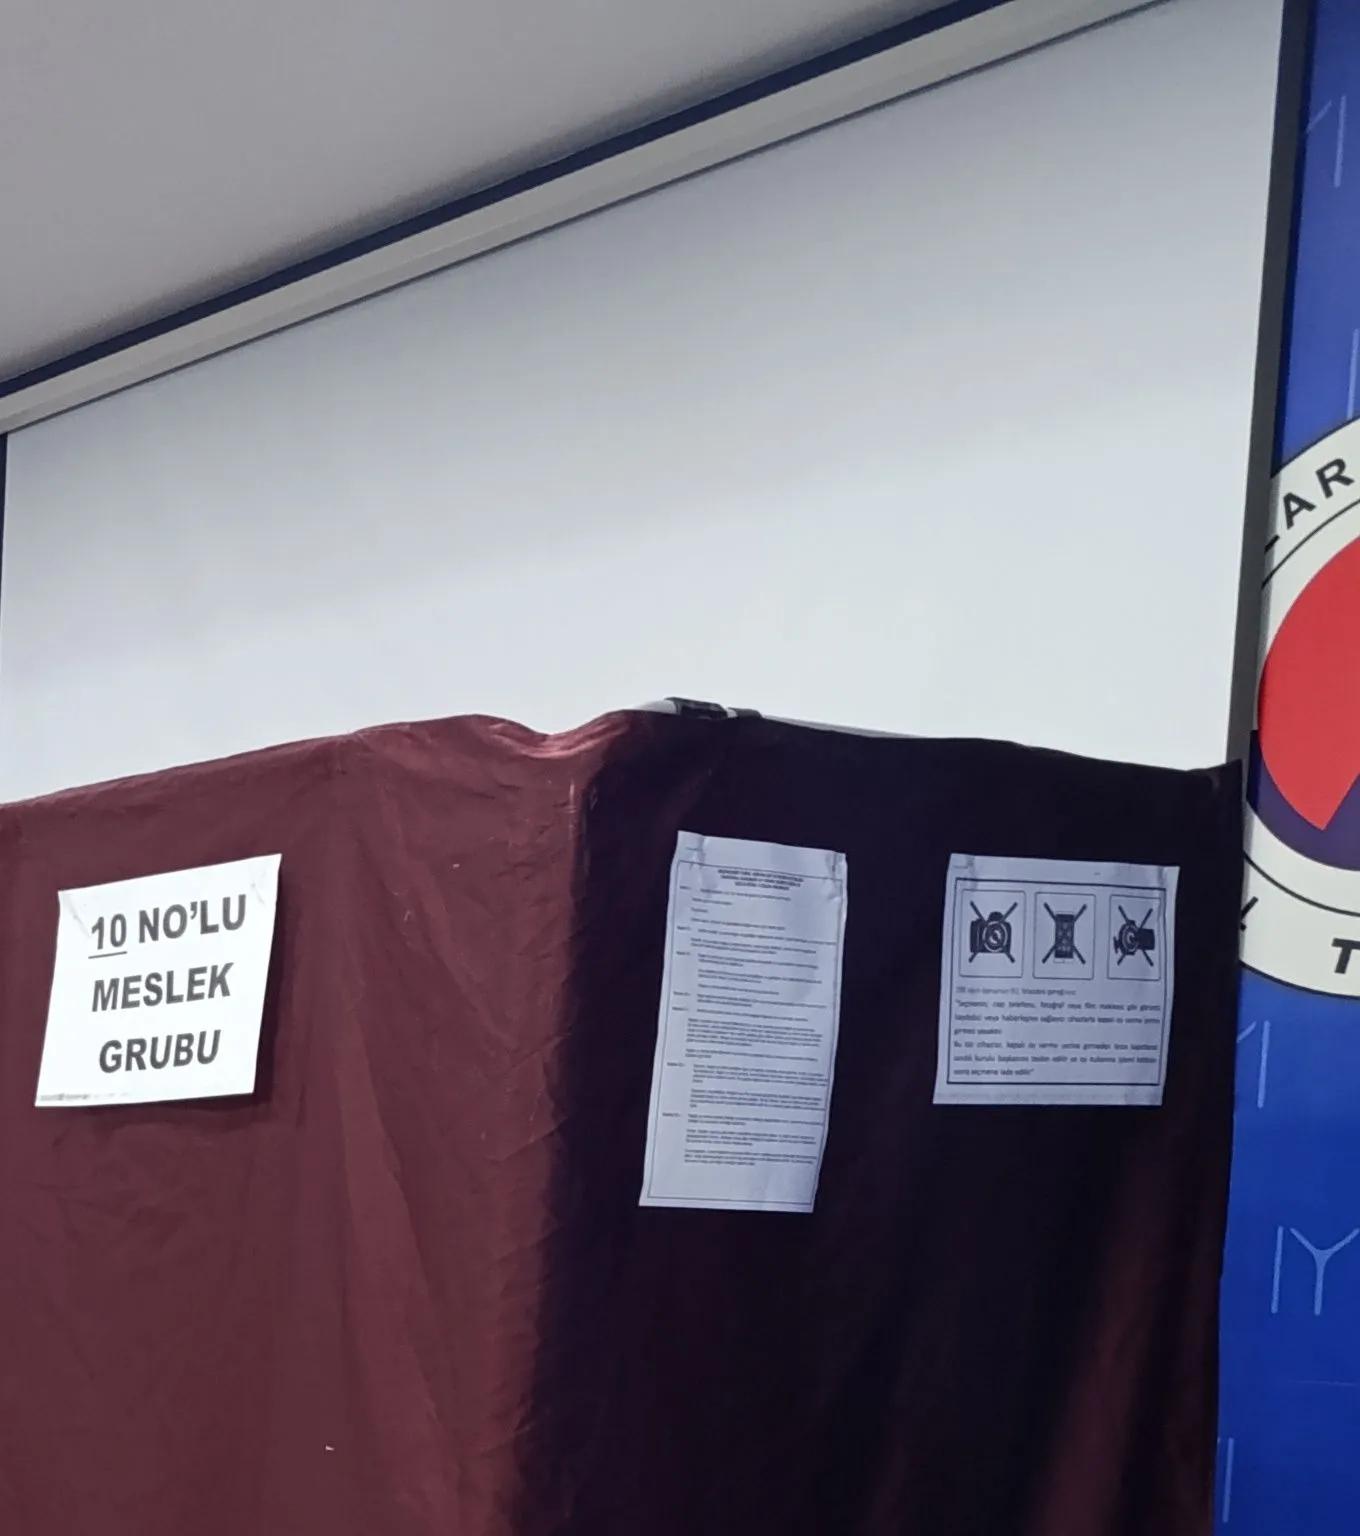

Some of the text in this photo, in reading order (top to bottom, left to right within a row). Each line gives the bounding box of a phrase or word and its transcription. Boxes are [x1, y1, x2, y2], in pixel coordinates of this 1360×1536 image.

[1264, 458, 1355, 554] AR
[91, 894, 247, 950] 10 NO'LU
[91, 962, 234, 1012] MESLEK
[98, 1029, 222, 1074] GRUBU
